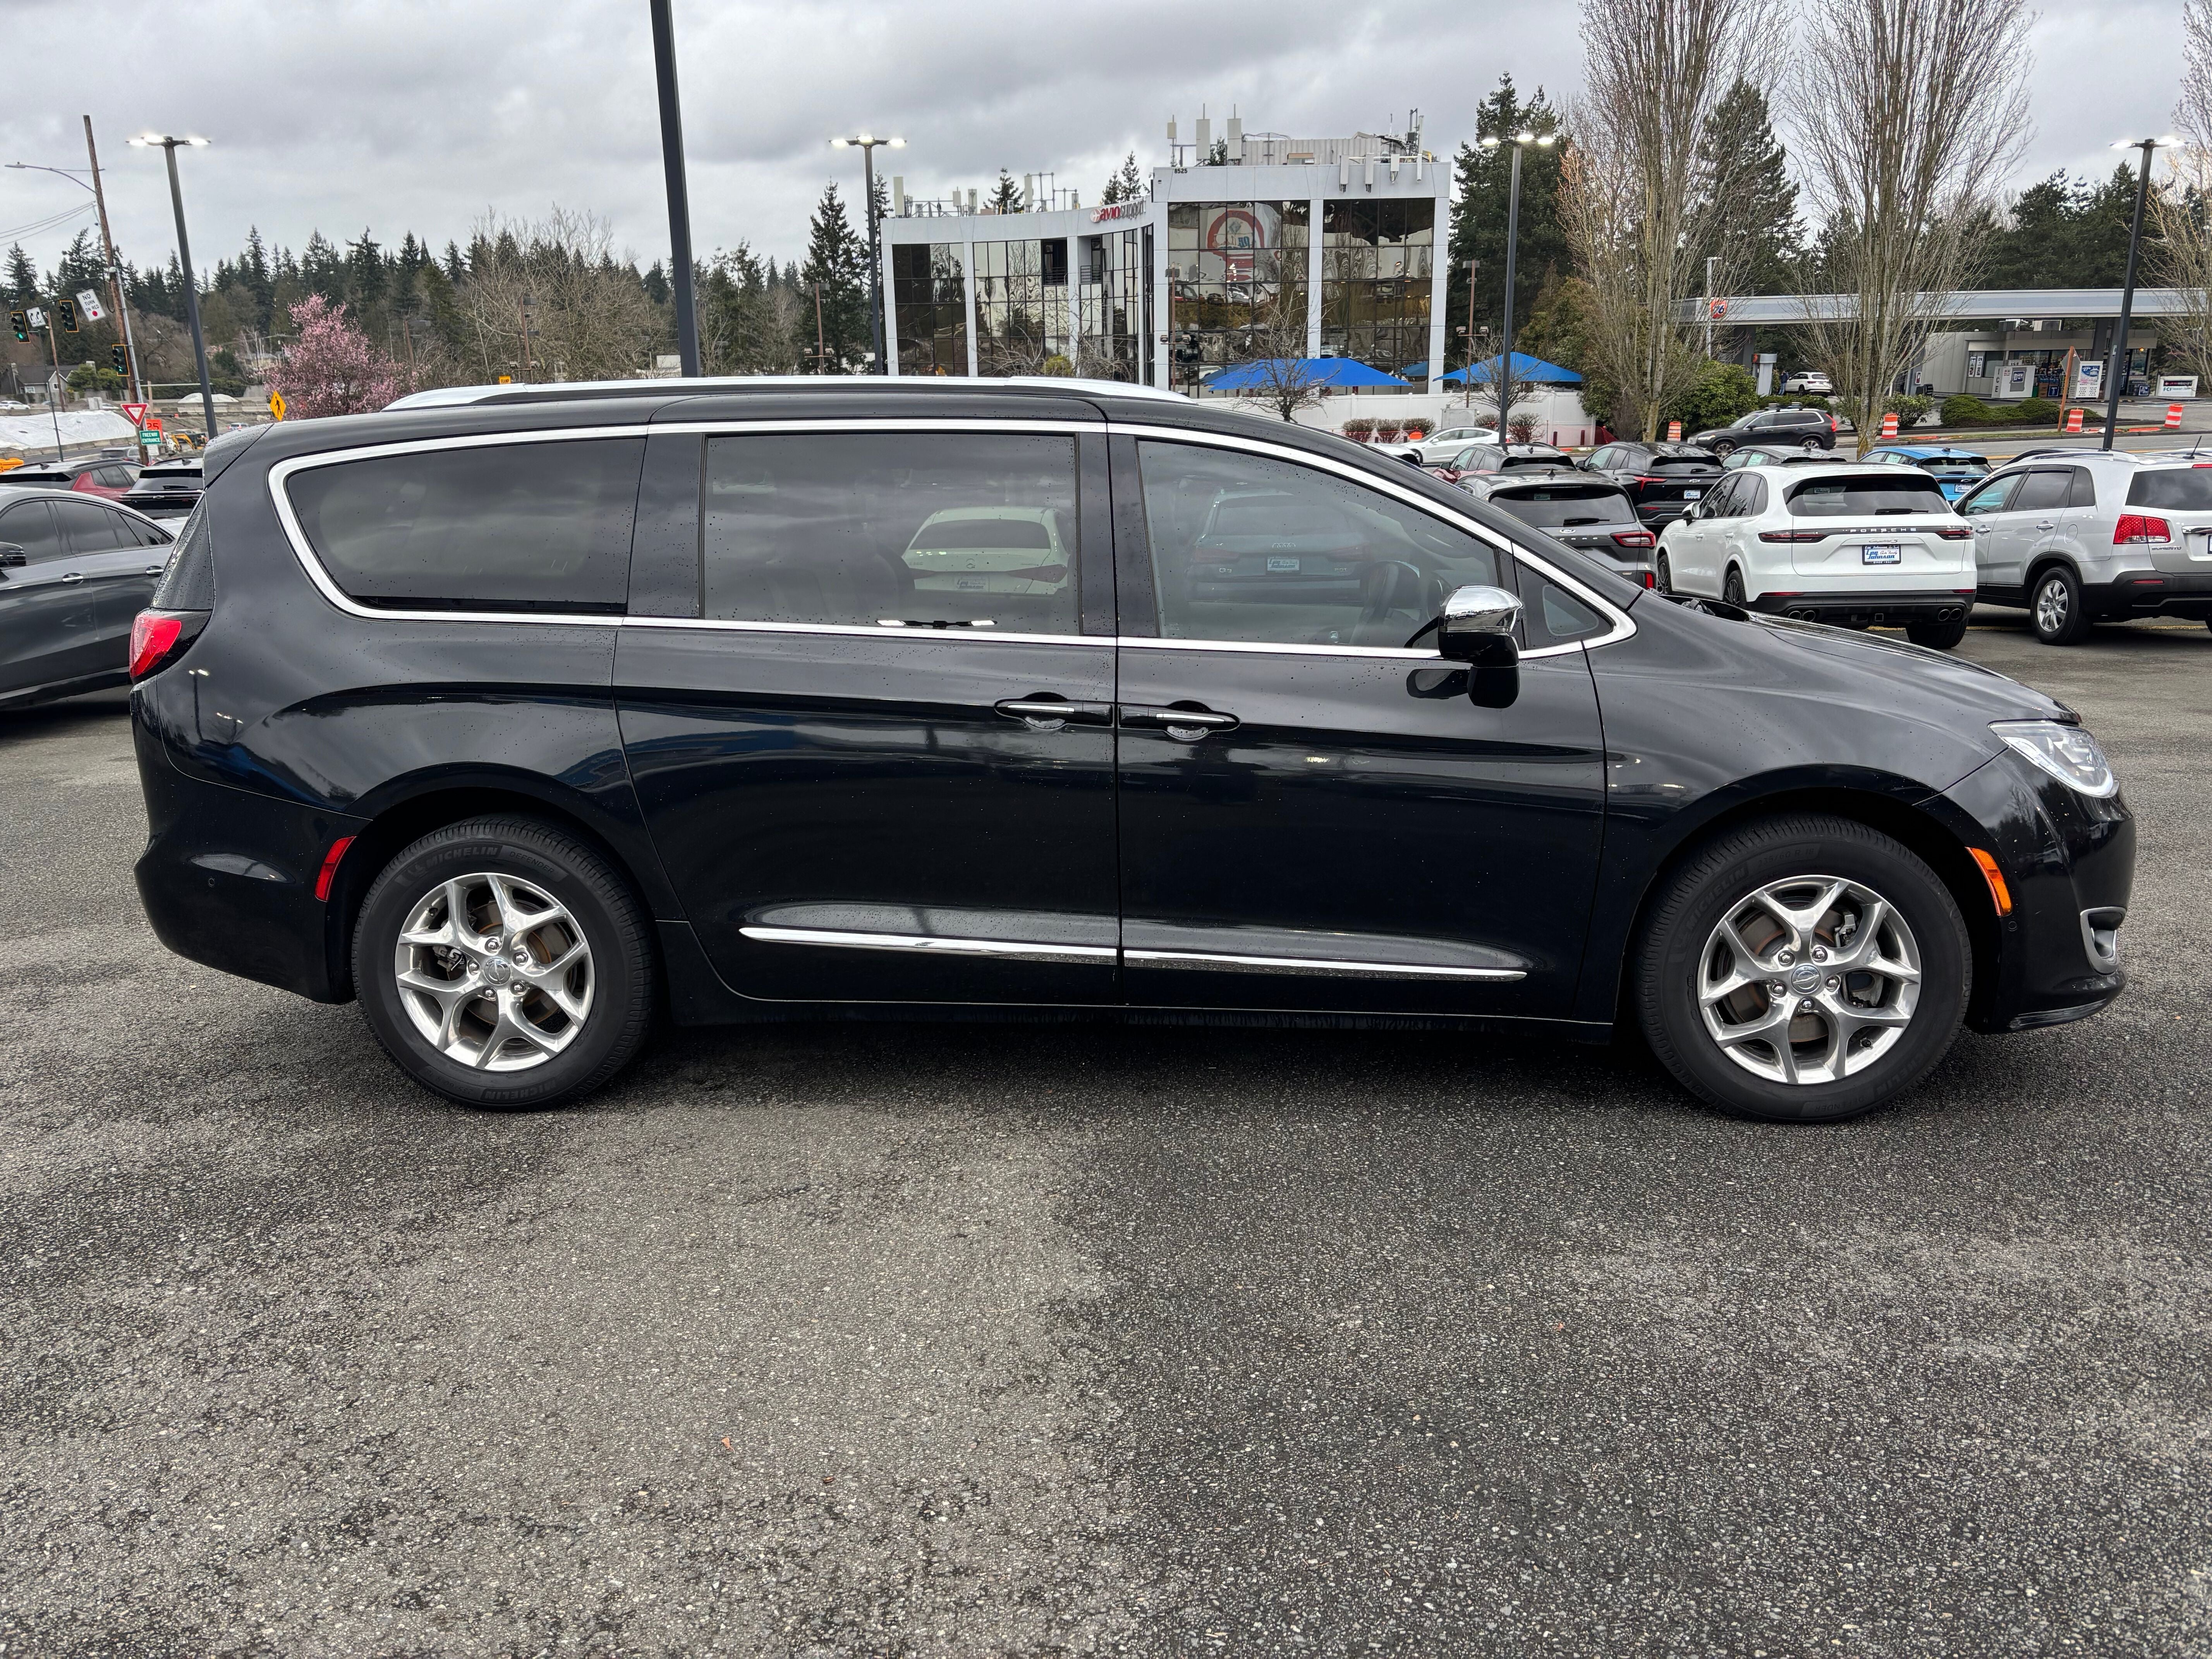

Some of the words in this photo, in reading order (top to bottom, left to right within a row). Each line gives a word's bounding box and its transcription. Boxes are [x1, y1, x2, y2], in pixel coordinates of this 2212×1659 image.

[426, 846, 498, 867] MICHELIN
[509, 851, 555, 874] DEFENDER
[1686, 867, 1745, 930] MICHELIN
[485, 1080, 557, 1099] MICHELIN
